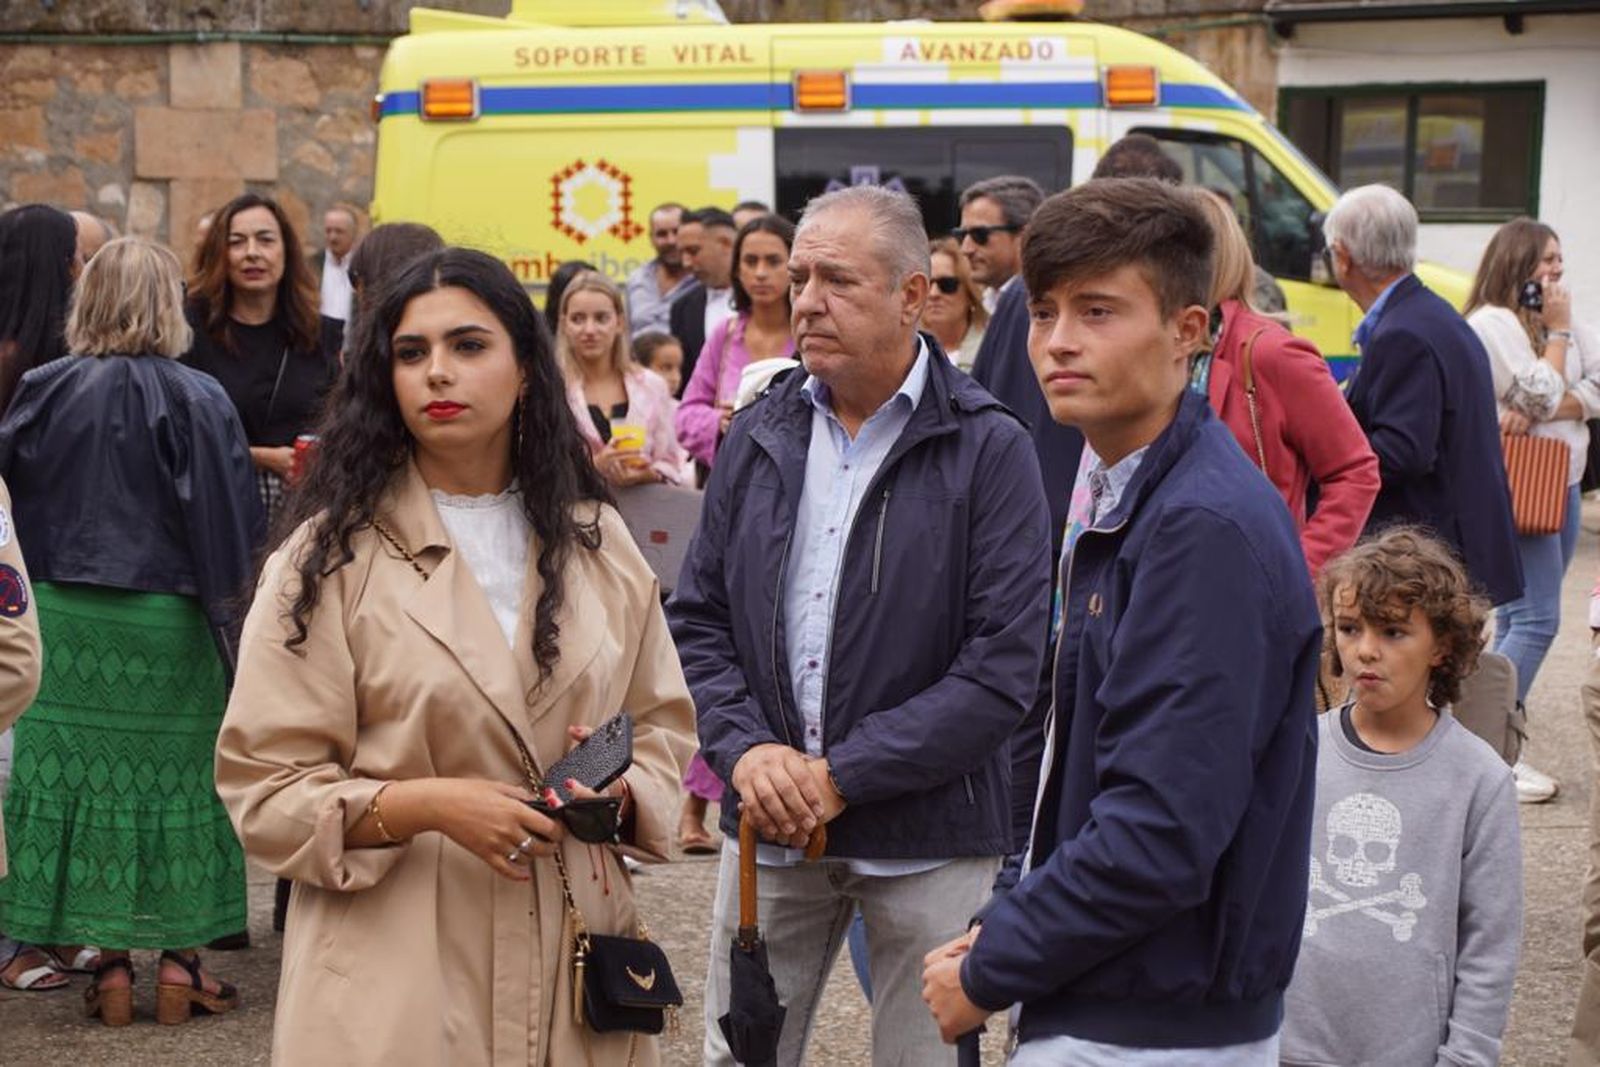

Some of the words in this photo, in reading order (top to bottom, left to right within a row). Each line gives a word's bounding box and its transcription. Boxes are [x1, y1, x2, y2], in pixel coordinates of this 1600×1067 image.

[514, 45, 647, 68] SOPORTE
[673, 44, 755, 64] VITAL
[900, 40, 1053, 61] AVANZADO
